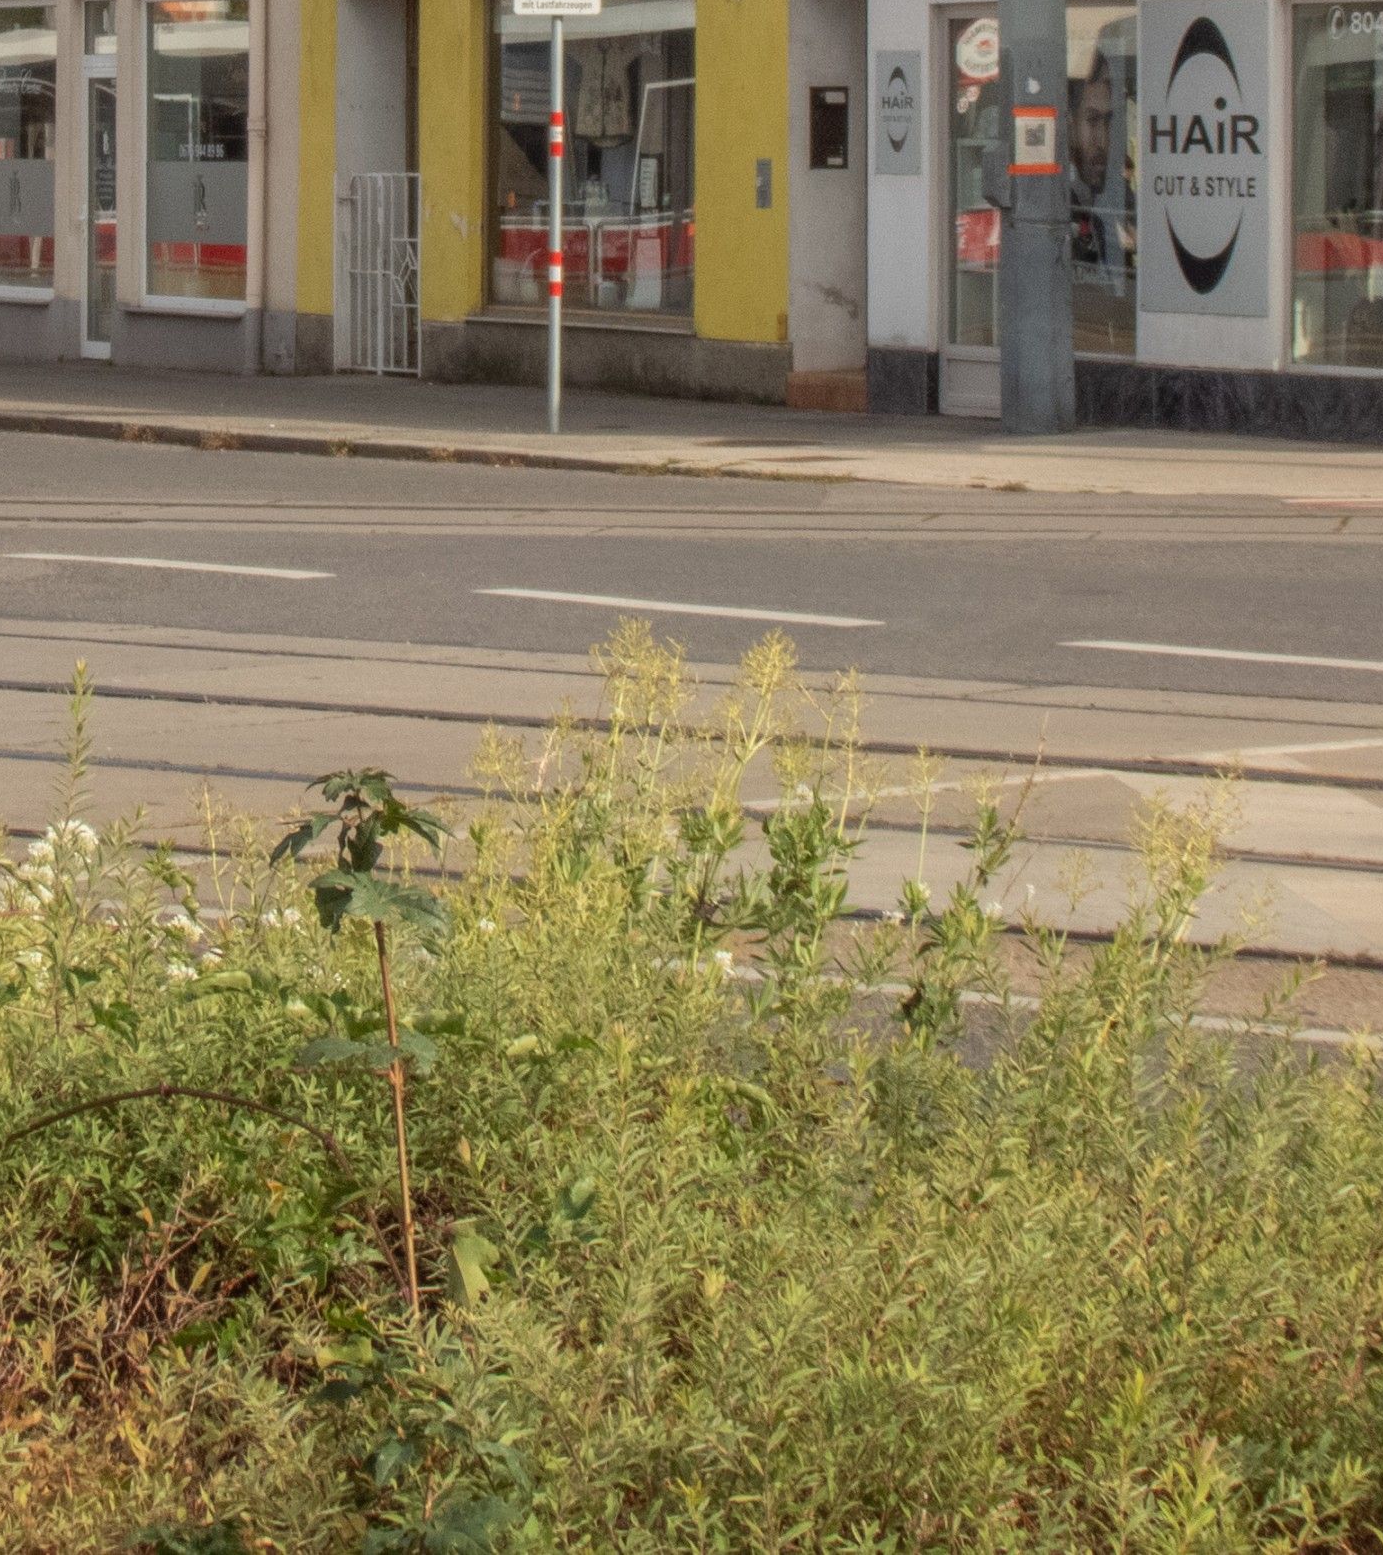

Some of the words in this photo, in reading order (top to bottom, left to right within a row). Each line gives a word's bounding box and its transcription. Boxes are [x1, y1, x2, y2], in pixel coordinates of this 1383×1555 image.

[522, 1, 533, 9] mit
[537, 1, 592, 11] Lastfahrzeugen
[1150, 97, 1261, 154] HAiR
[1154, 176, 1184, 196] CUT
[1190, 176, 1200, 197] &
[1205, 176, 1256, 198] STYLE
